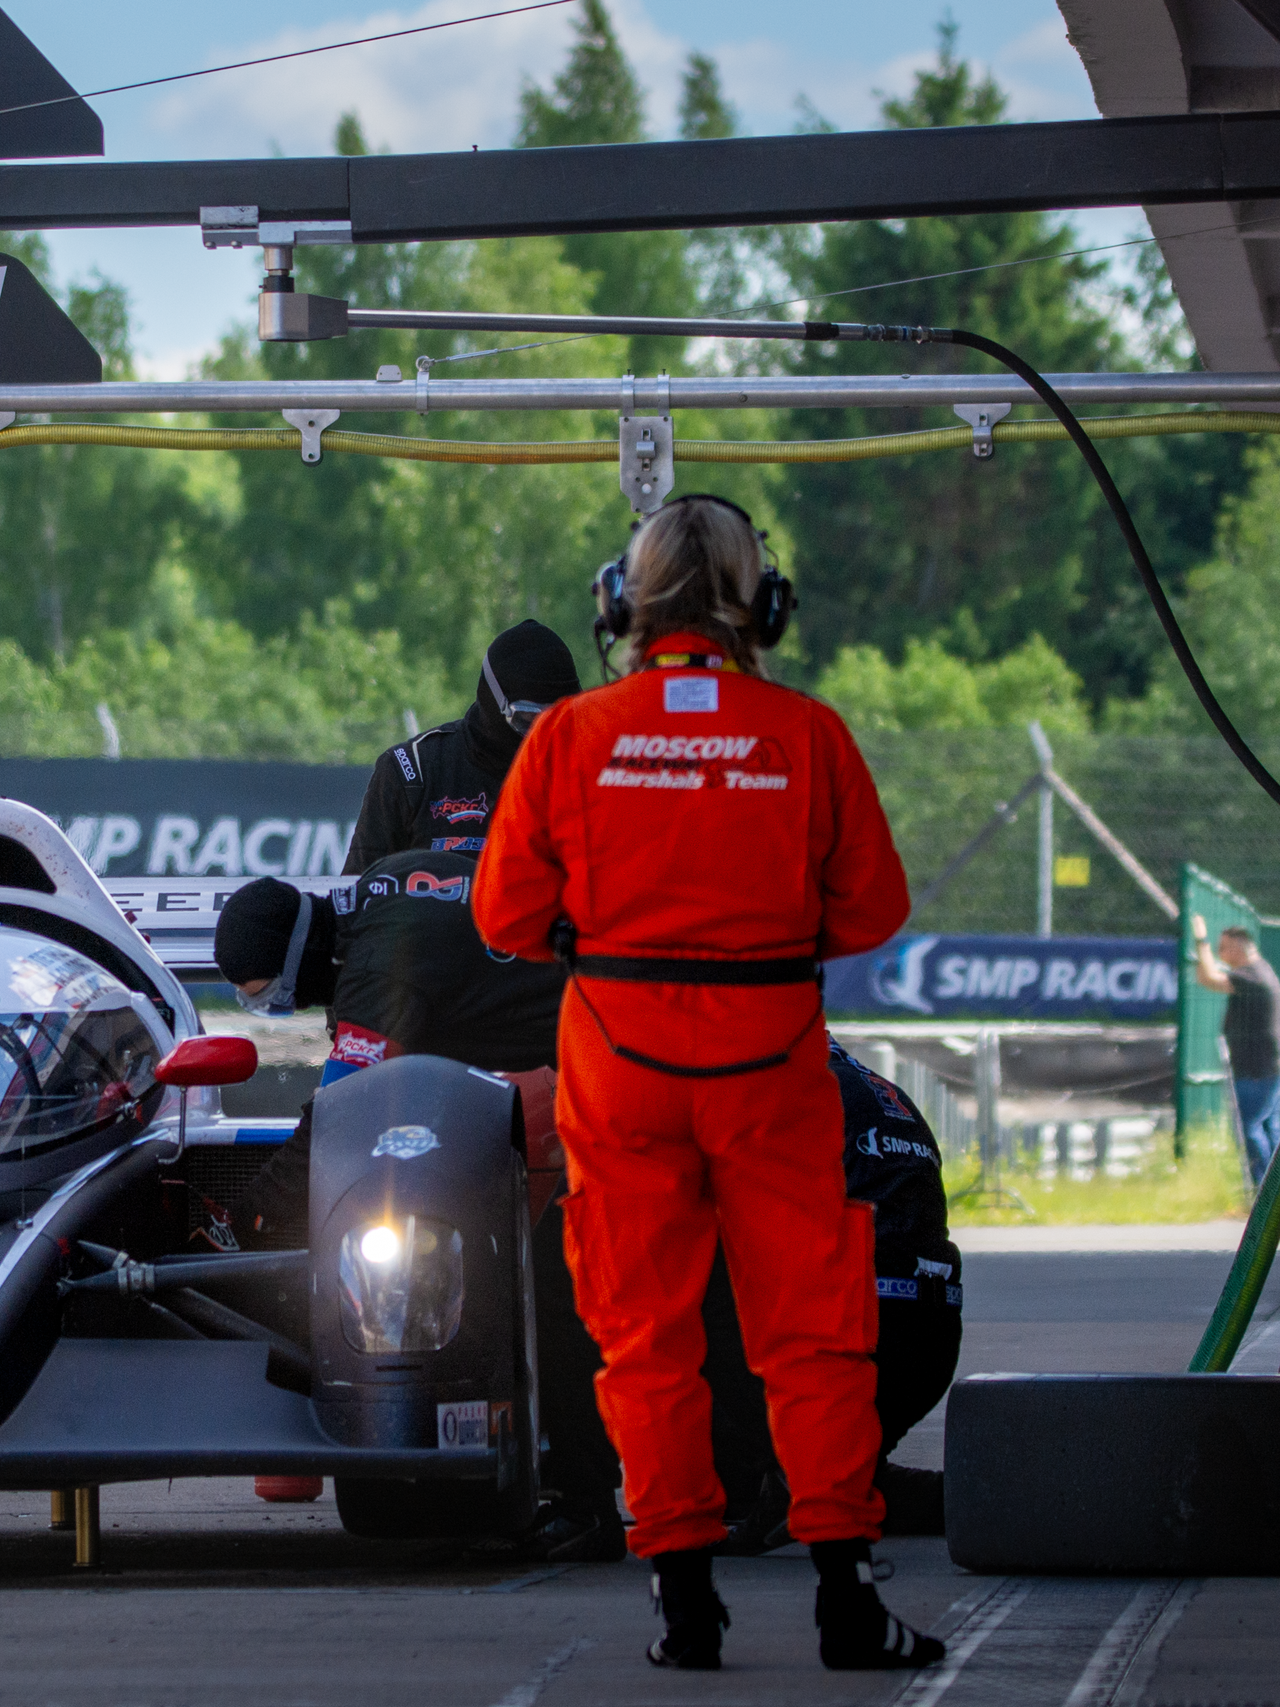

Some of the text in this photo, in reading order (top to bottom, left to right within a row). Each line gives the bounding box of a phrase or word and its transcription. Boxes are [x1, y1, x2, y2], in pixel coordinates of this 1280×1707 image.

[611, 734, 759, 760] MOSCOW
[394, 747, 417, 781] sparco
[596, 767, 789, 791] Marshals Team
[64, 813, 366, 876] MP RACIN
[936, 956, 1179, 1002] SMP RACIN
[882, 1136, 911, 1155] SMP
[877, 1279, 918, 1296] arco
